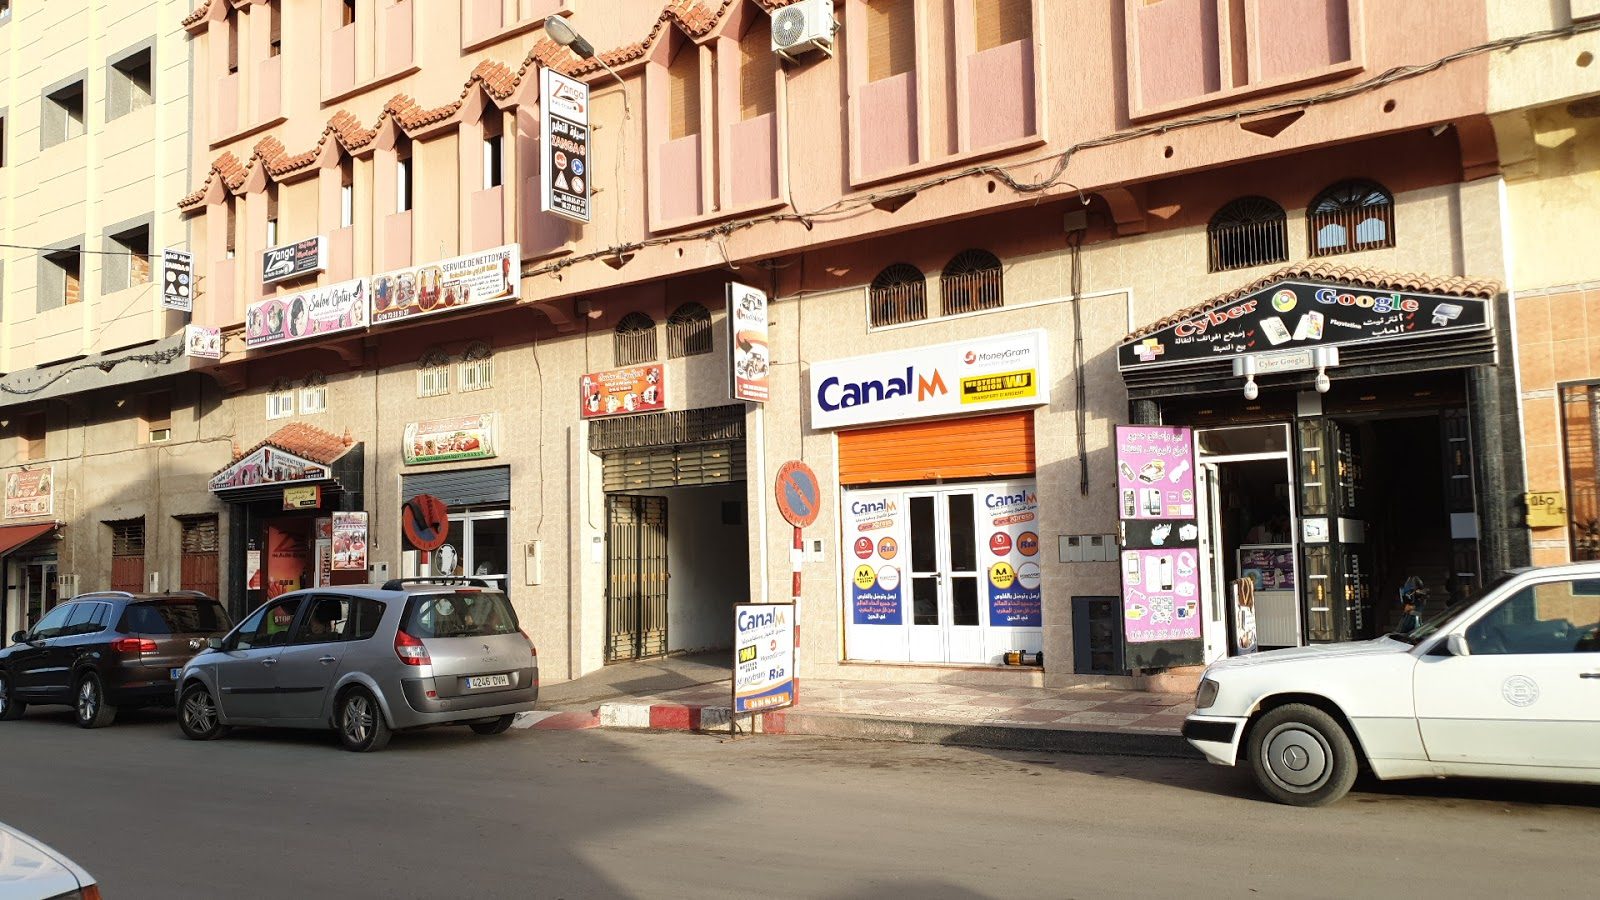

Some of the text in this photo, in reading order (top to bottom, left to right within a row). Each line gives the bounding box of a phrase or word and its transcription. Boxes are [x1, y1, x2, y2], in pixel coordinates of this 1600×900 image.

[552, 79, 585, 100] Zanga
[551, 134, 580, 155] ZANGA
[265, 247, 295, 273] Zanga
[443, 258, 468, 273] SERVICE
[467, 257, 476, 268] DE
[476, 250, 511, 267] NETTOYAGE
[309, 294, 330, 312] Salon
[1314, 288, 1419, 313] Google
[1174, 299, 1258, 337] Cyber
[1329, 318, 1363, 330] Playstation
[1174, 337, 1195, 345] النقالة
[1223, 330, 1246, 342] إصلاح
[978, 347, 1030, 362] MoneyGram
[1258, 356, 1305, 369] Cyber Google
[817, 365, 948, 413] Canal M
[965, 377, 1002, 388] WESTERN
[976, 382, 1002, 392] UNION
[851, 498, 897, 516] Canal M
[985, 490, 1038, 510] Canal M
[880, 541, 895, 553] Ria
[1020, 539, 1037, 549] Ria
[274, 615, 291, 623] STOP
[738, 607, 776, 633] Canal
[472, 675, 507, 687] 4246 DVH
[768, 669, 785, 681] Ria
